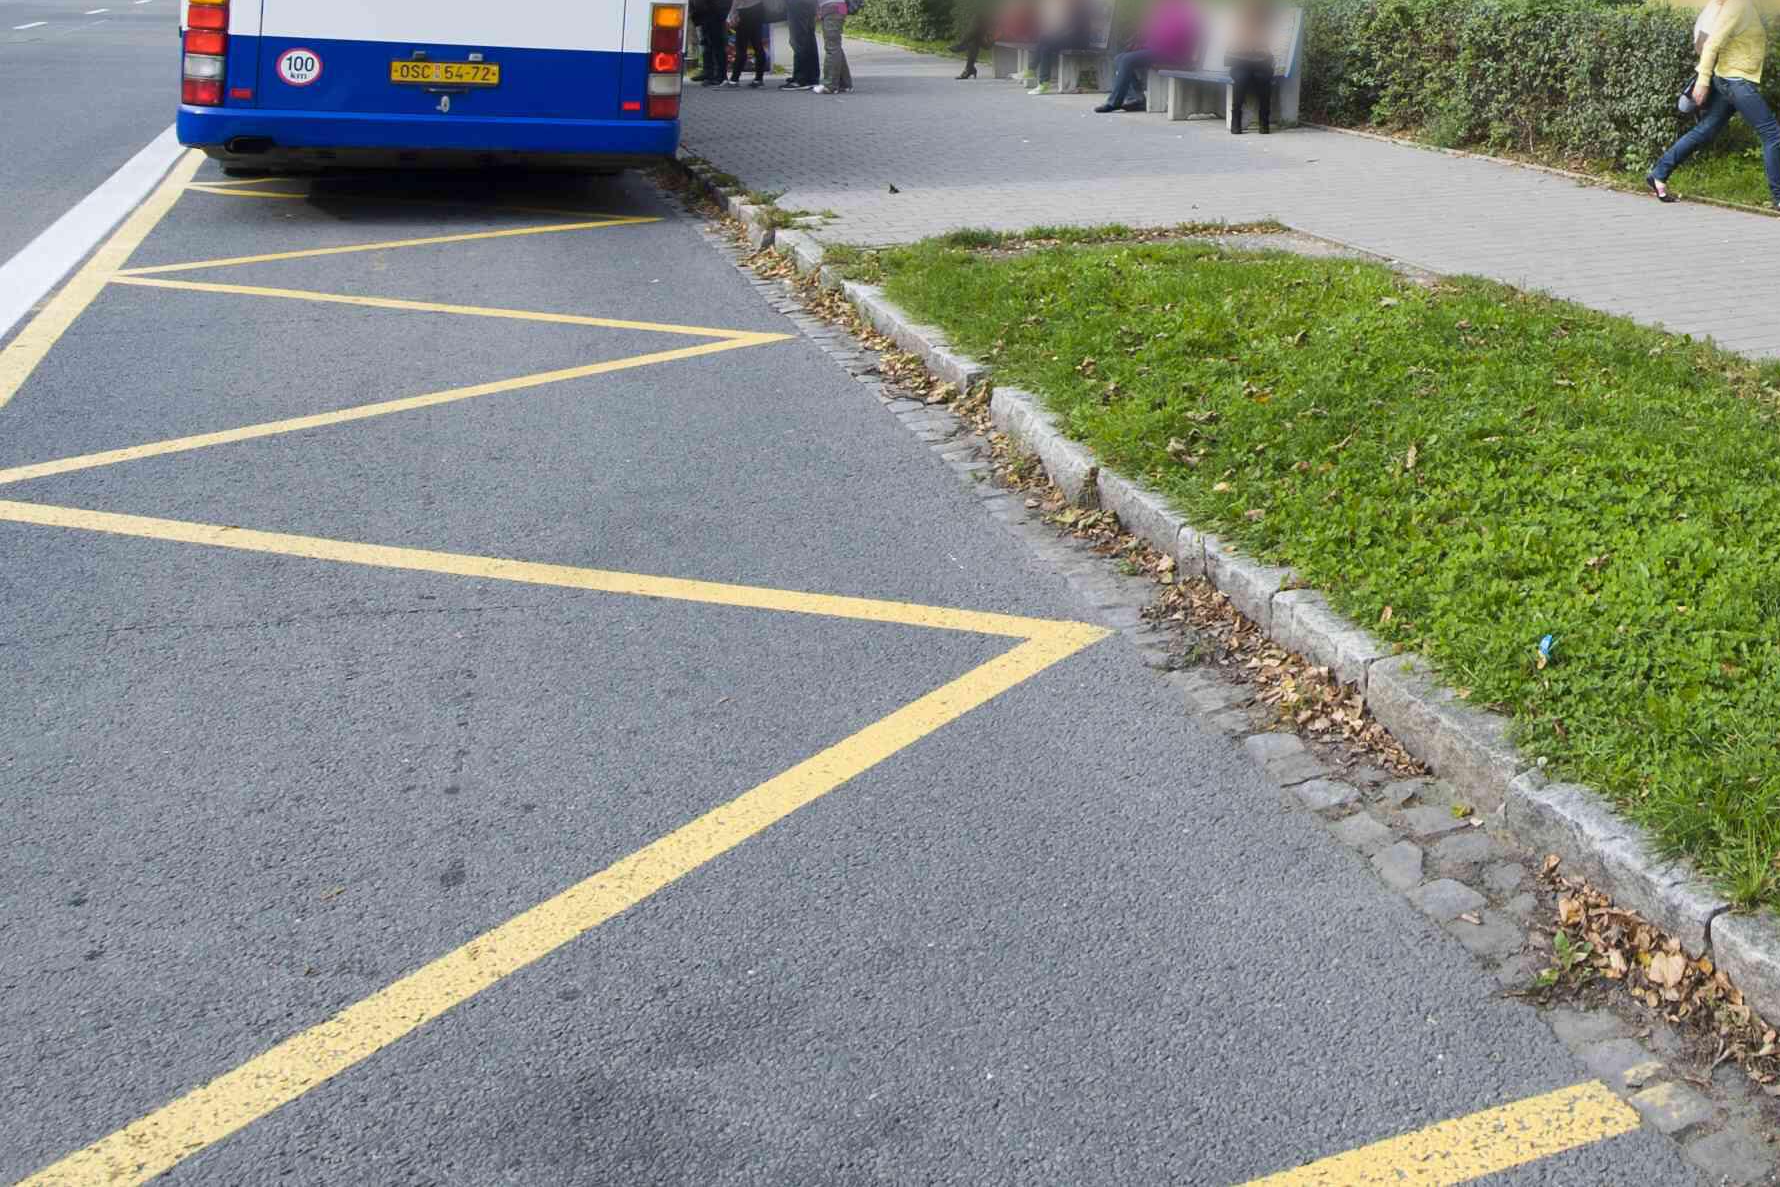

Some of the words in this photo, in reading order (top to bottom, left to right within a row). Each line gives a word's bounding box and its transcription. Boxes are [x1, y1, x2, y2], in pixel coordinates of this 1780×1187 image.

[286, 55, 315, 72] 100
[290, 72, 309, 80] km
[400, 67, 430, 79] OSC
